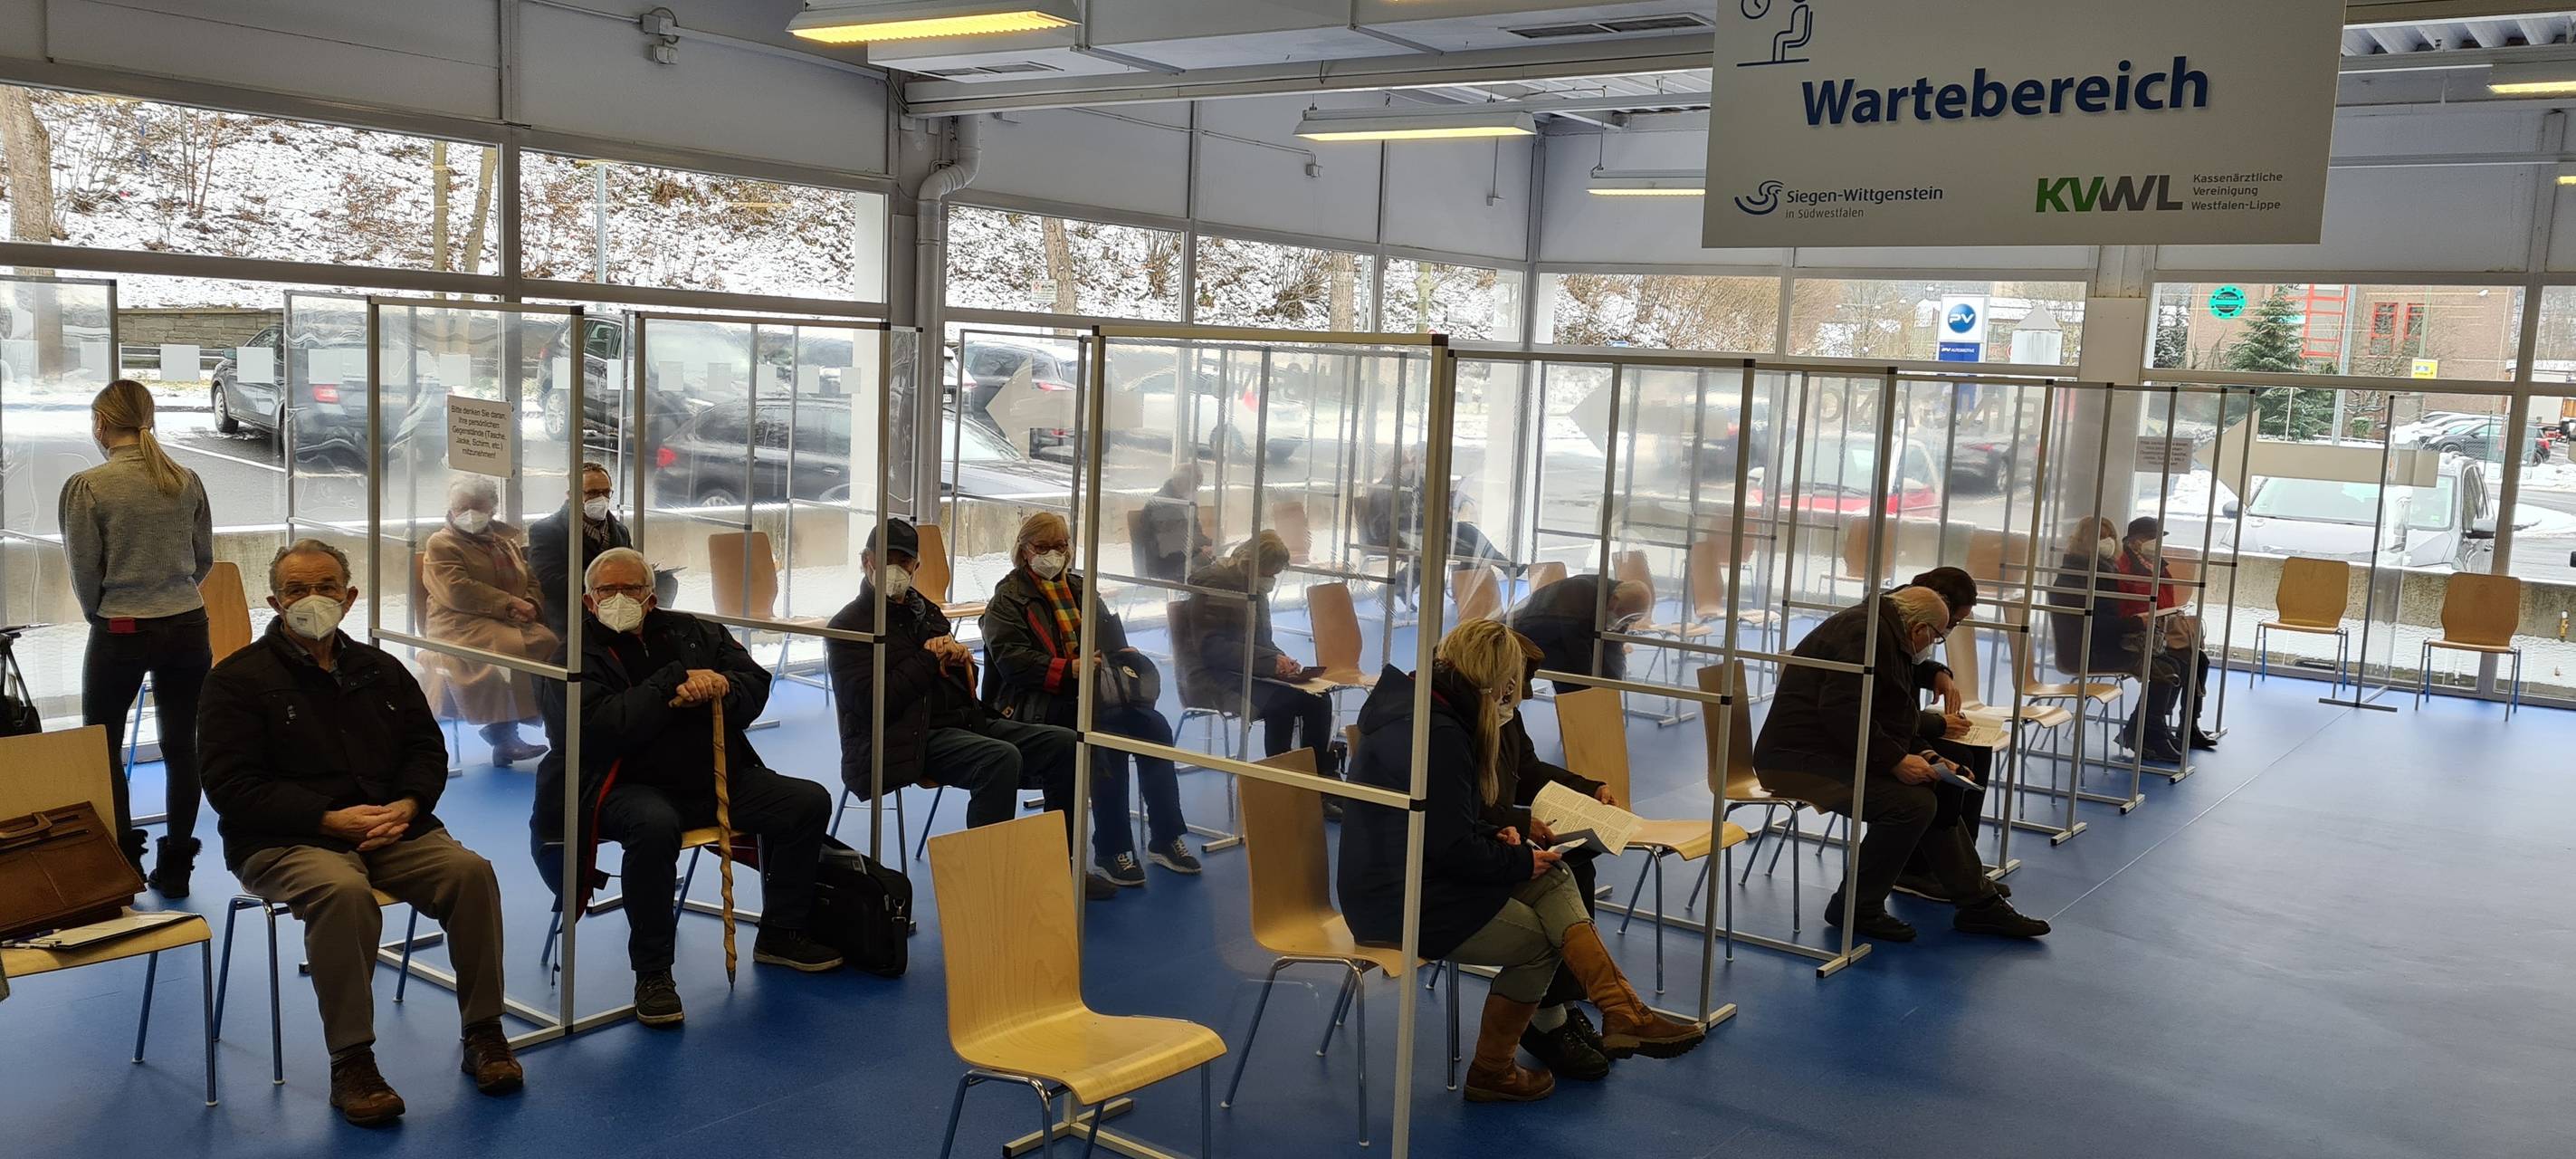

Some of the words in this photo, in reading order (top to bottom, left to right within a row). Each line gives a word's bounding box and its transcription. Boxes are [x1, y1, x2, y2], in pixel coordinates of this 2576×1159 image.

[1801, 55, 2209, 127] Wartebereich
[2192, 172, 2284, 184] Kassenärztliche
[1786, 186, 1944, 206] Siegen-Wittgenstein
[2035, 174, 2184, 213] KVWL
[2192, 185, 2259, 197] Vereinigung
[2190, 199, 2282, 212] Westfalen-Lippe
[1785, 208, 1795, 219] in
[1798, 207, 1865, 219] Südwestfalen
[1949, 313, 1975, 324] PV
